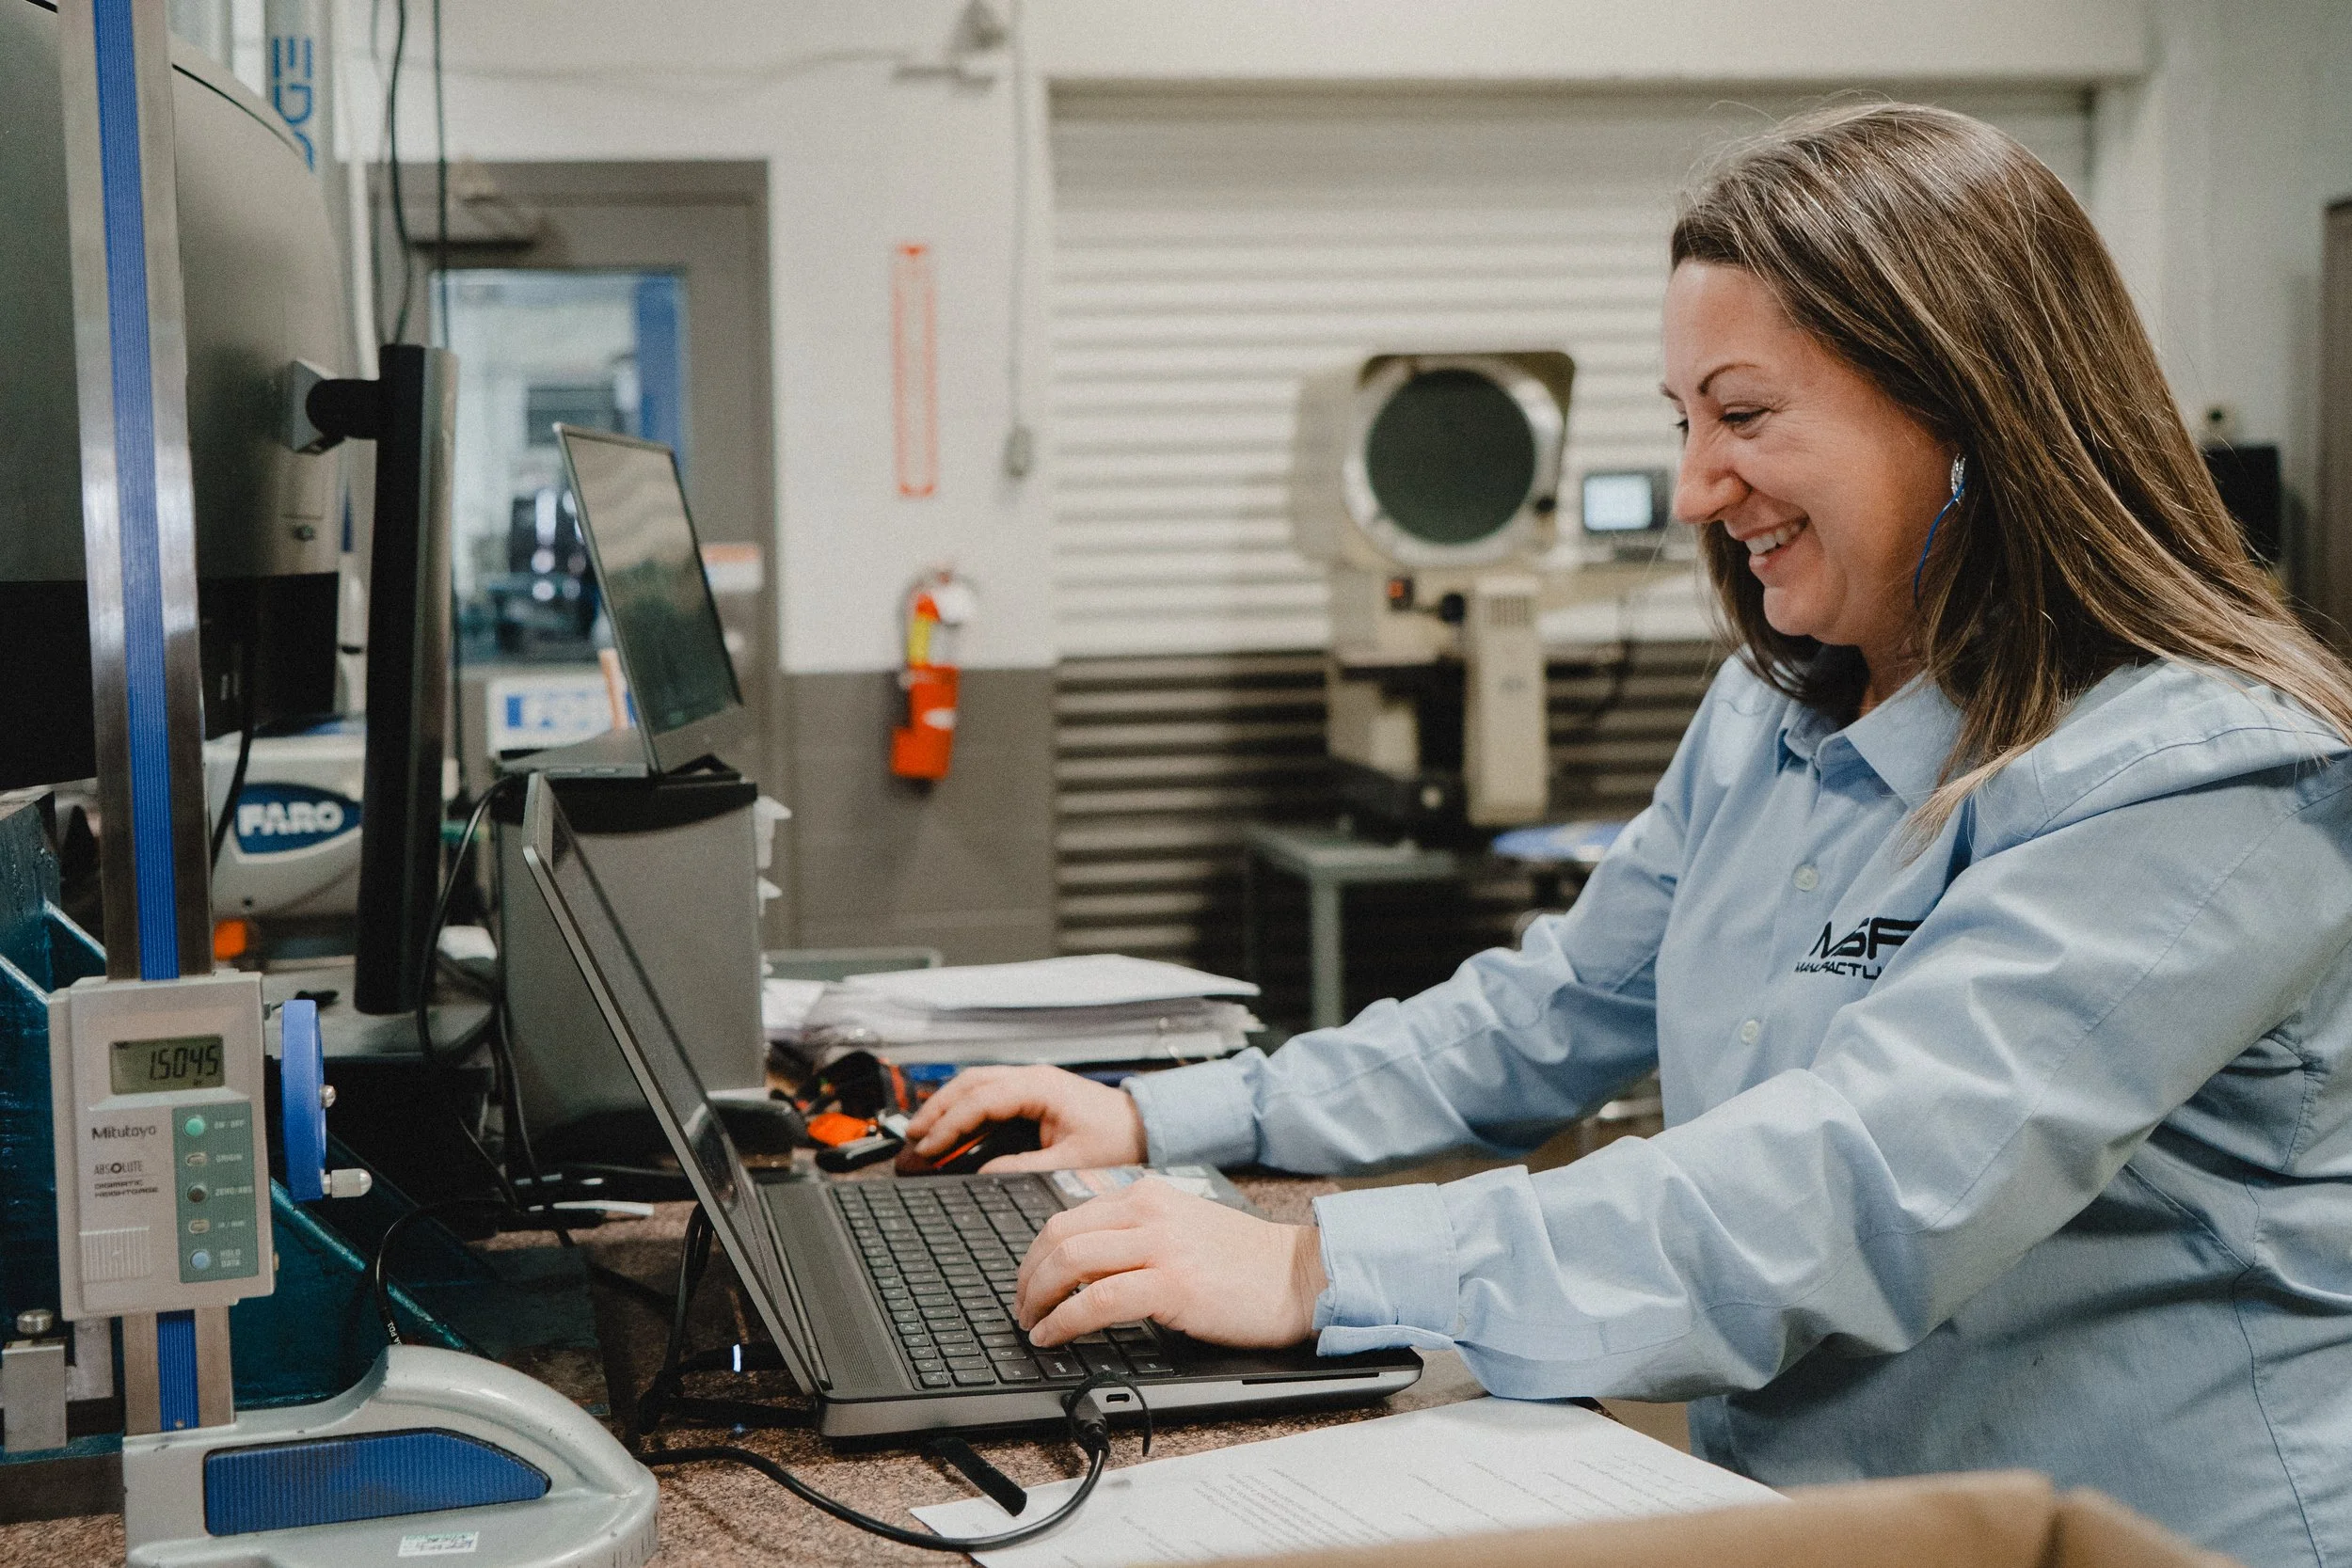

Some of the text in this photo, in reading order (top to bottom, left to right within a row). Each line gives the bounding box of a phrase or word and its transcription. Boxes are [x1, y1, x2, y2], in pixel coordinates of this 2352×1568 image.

[237, 800, 345, 837] FARO
[91, 1124, 156, 1140] Mitutoyo
[95, 1160, 143, 1175] ABSOLUTE
